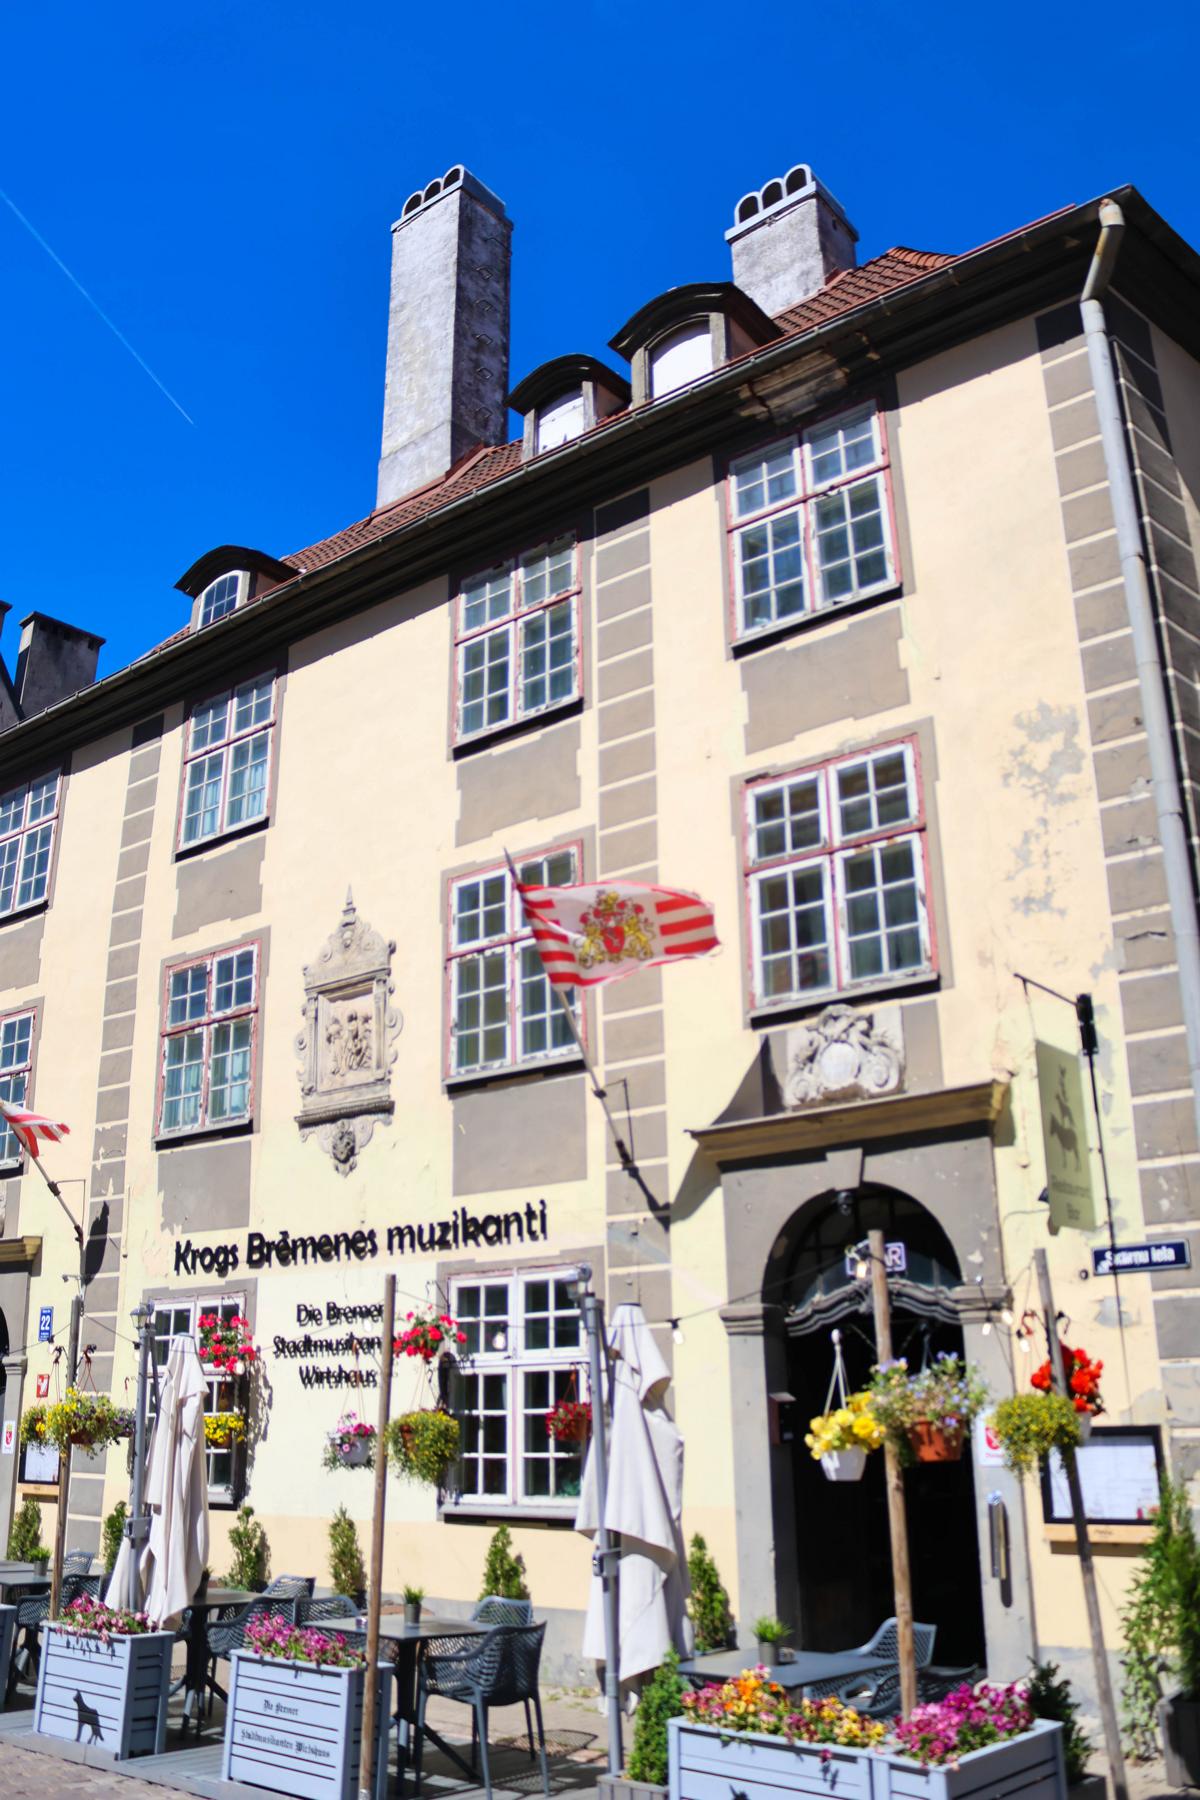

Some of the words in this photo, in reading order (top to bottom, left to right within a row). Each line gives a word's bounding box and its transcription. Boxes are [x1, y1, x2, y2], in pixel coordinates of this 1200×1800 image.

[174, 1239, 239, 1278] Krogs
[387, 1199, 547, 1256] muzikanti
[41, 1314, 51, 1331] 22
[296, 1303, 323, 1327] Die
[326, 1301, 384, 1326] Bremer
[273, 1331, 382, 1359] Stadtmusikan
[299, 1364, 377, 1390] Wirtshaus
